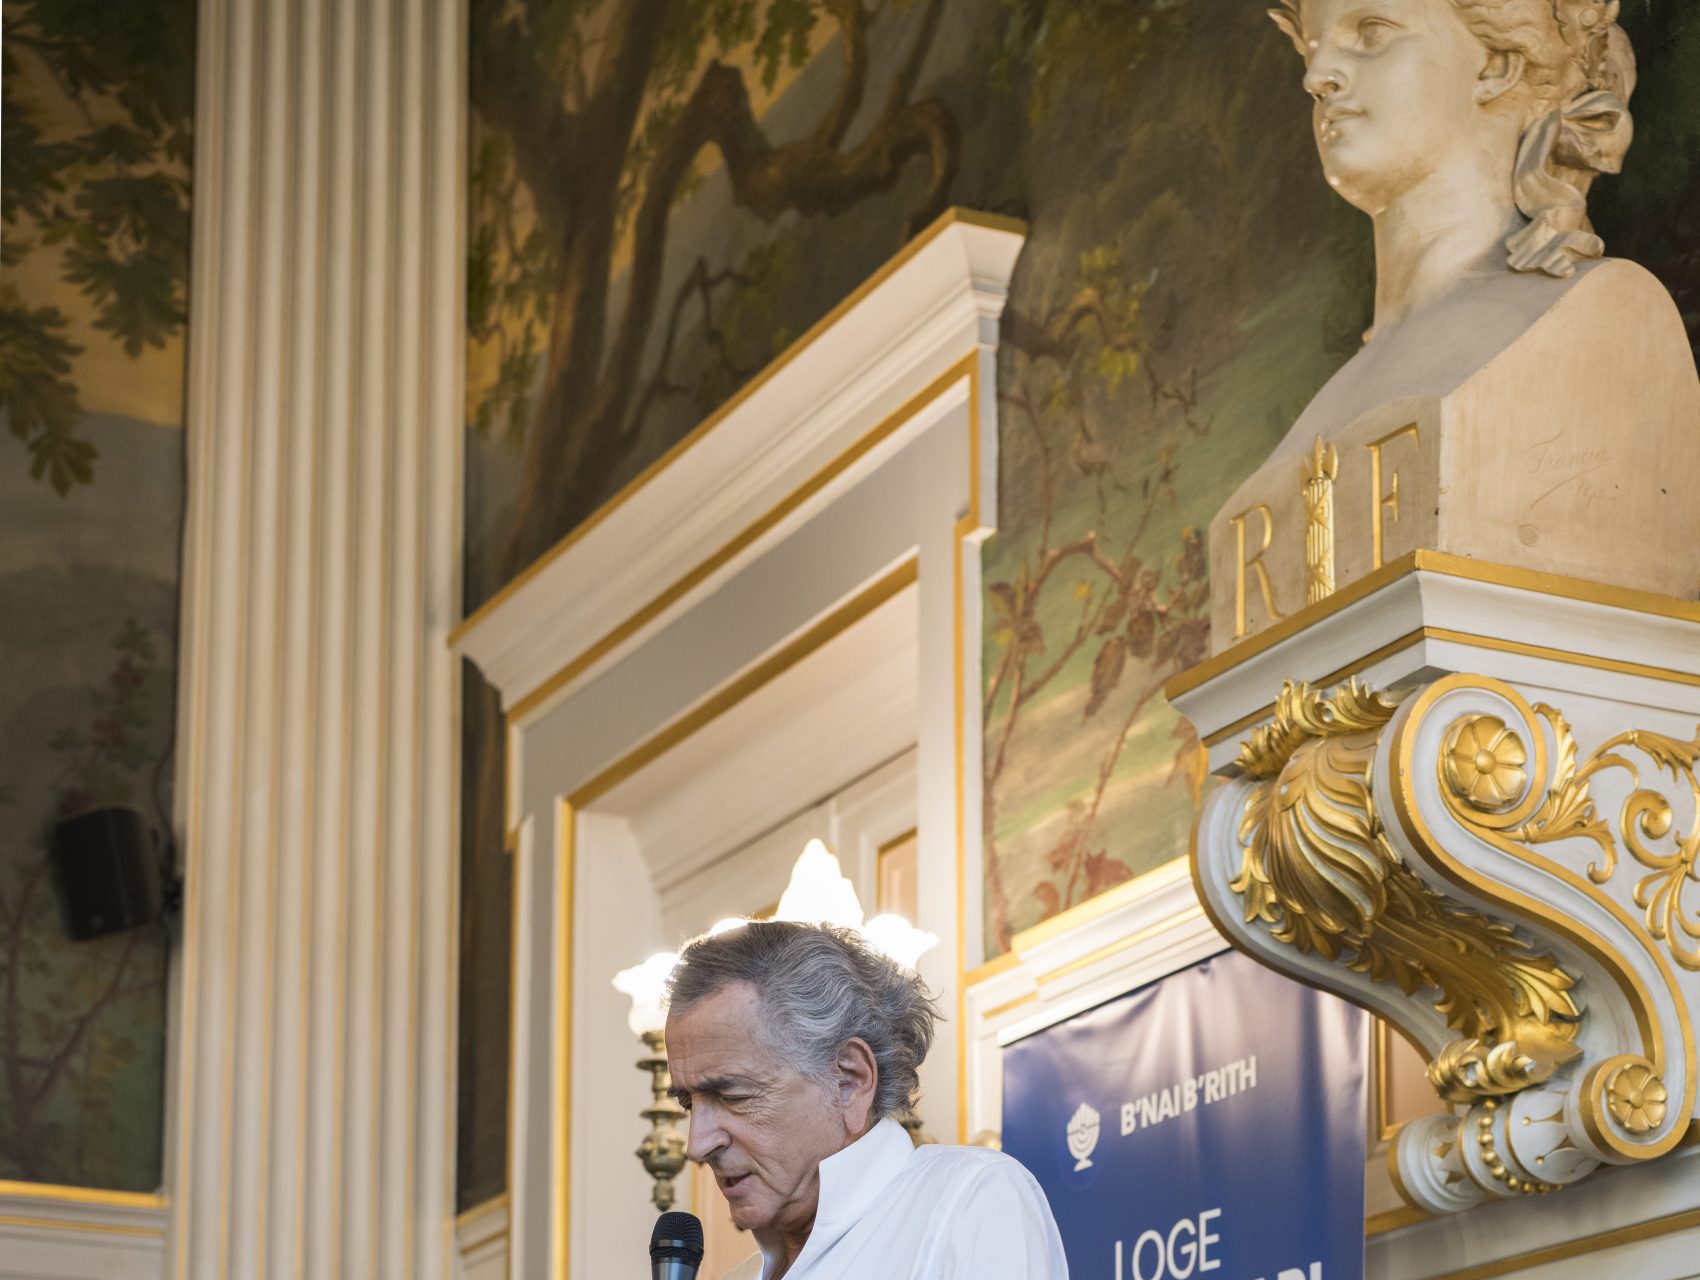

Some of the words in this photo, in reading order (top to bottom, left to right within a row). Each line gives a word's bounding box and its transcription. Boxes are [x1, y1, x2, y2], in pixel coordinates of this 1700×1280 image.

[1229, 503, 1286, 642] R
[1365, 421, 1421, 571] F
[1120, 1084, 1181, 1137] B'NAI
[1182, 1054, 1258, 1113] B'RITH
